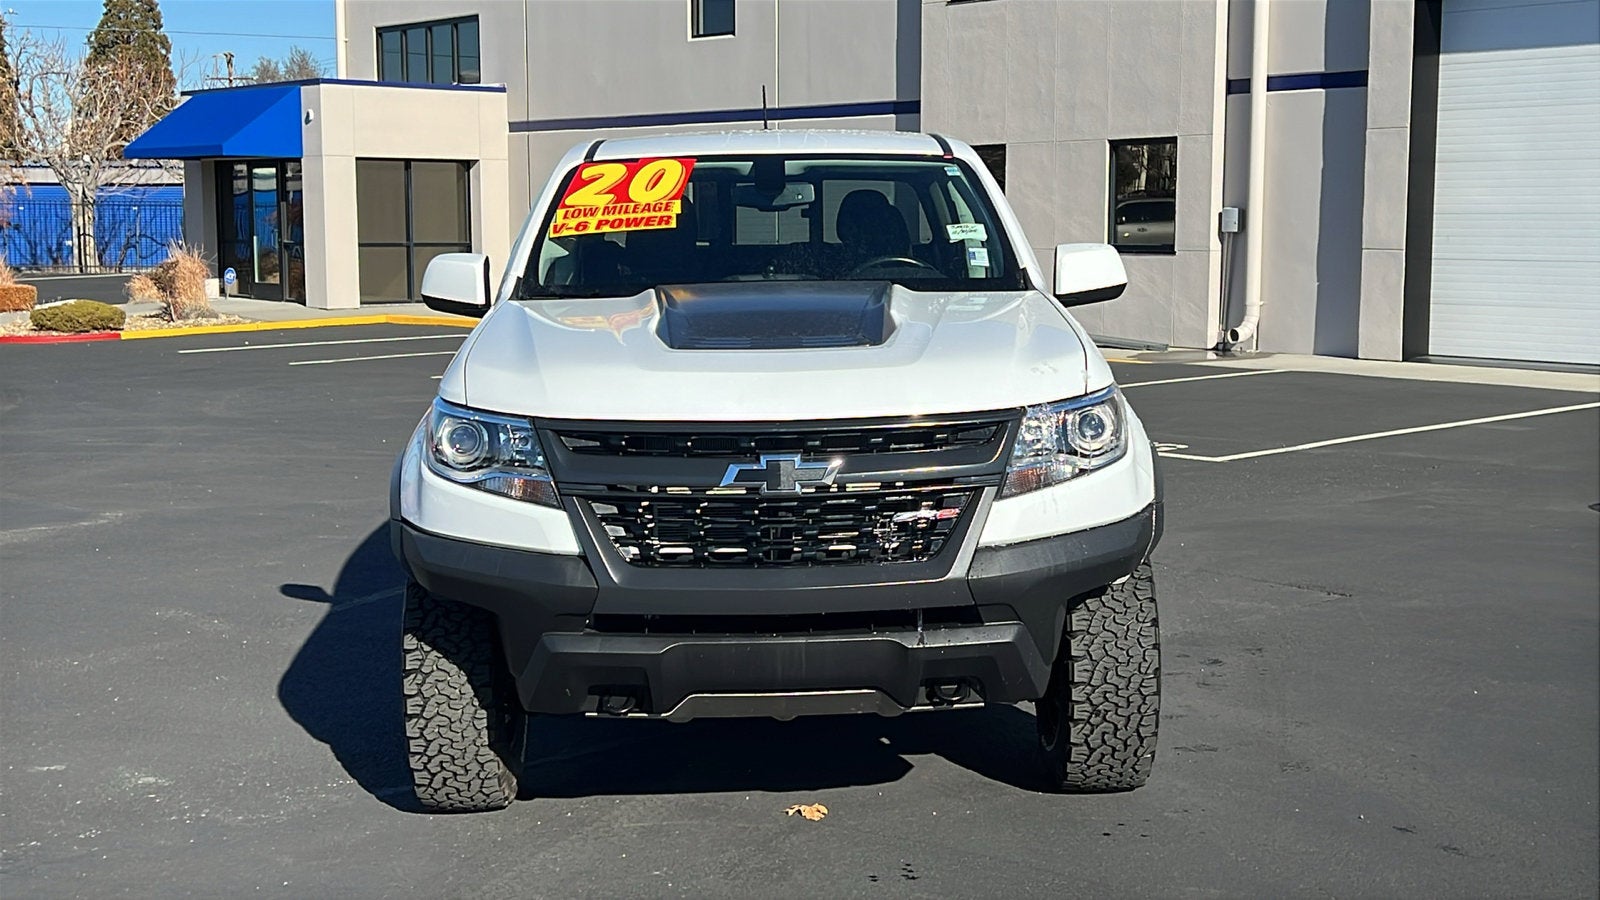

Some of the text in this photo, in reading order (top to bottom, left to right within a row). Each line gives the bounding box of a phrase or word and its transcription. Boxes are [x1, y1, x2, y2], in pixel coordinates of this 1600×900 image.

[564, 159, 687, 206] 20
[563, 202, 674, 220] LOW MILEAGE
[552, 215, 672, 234] V-6 POWER
